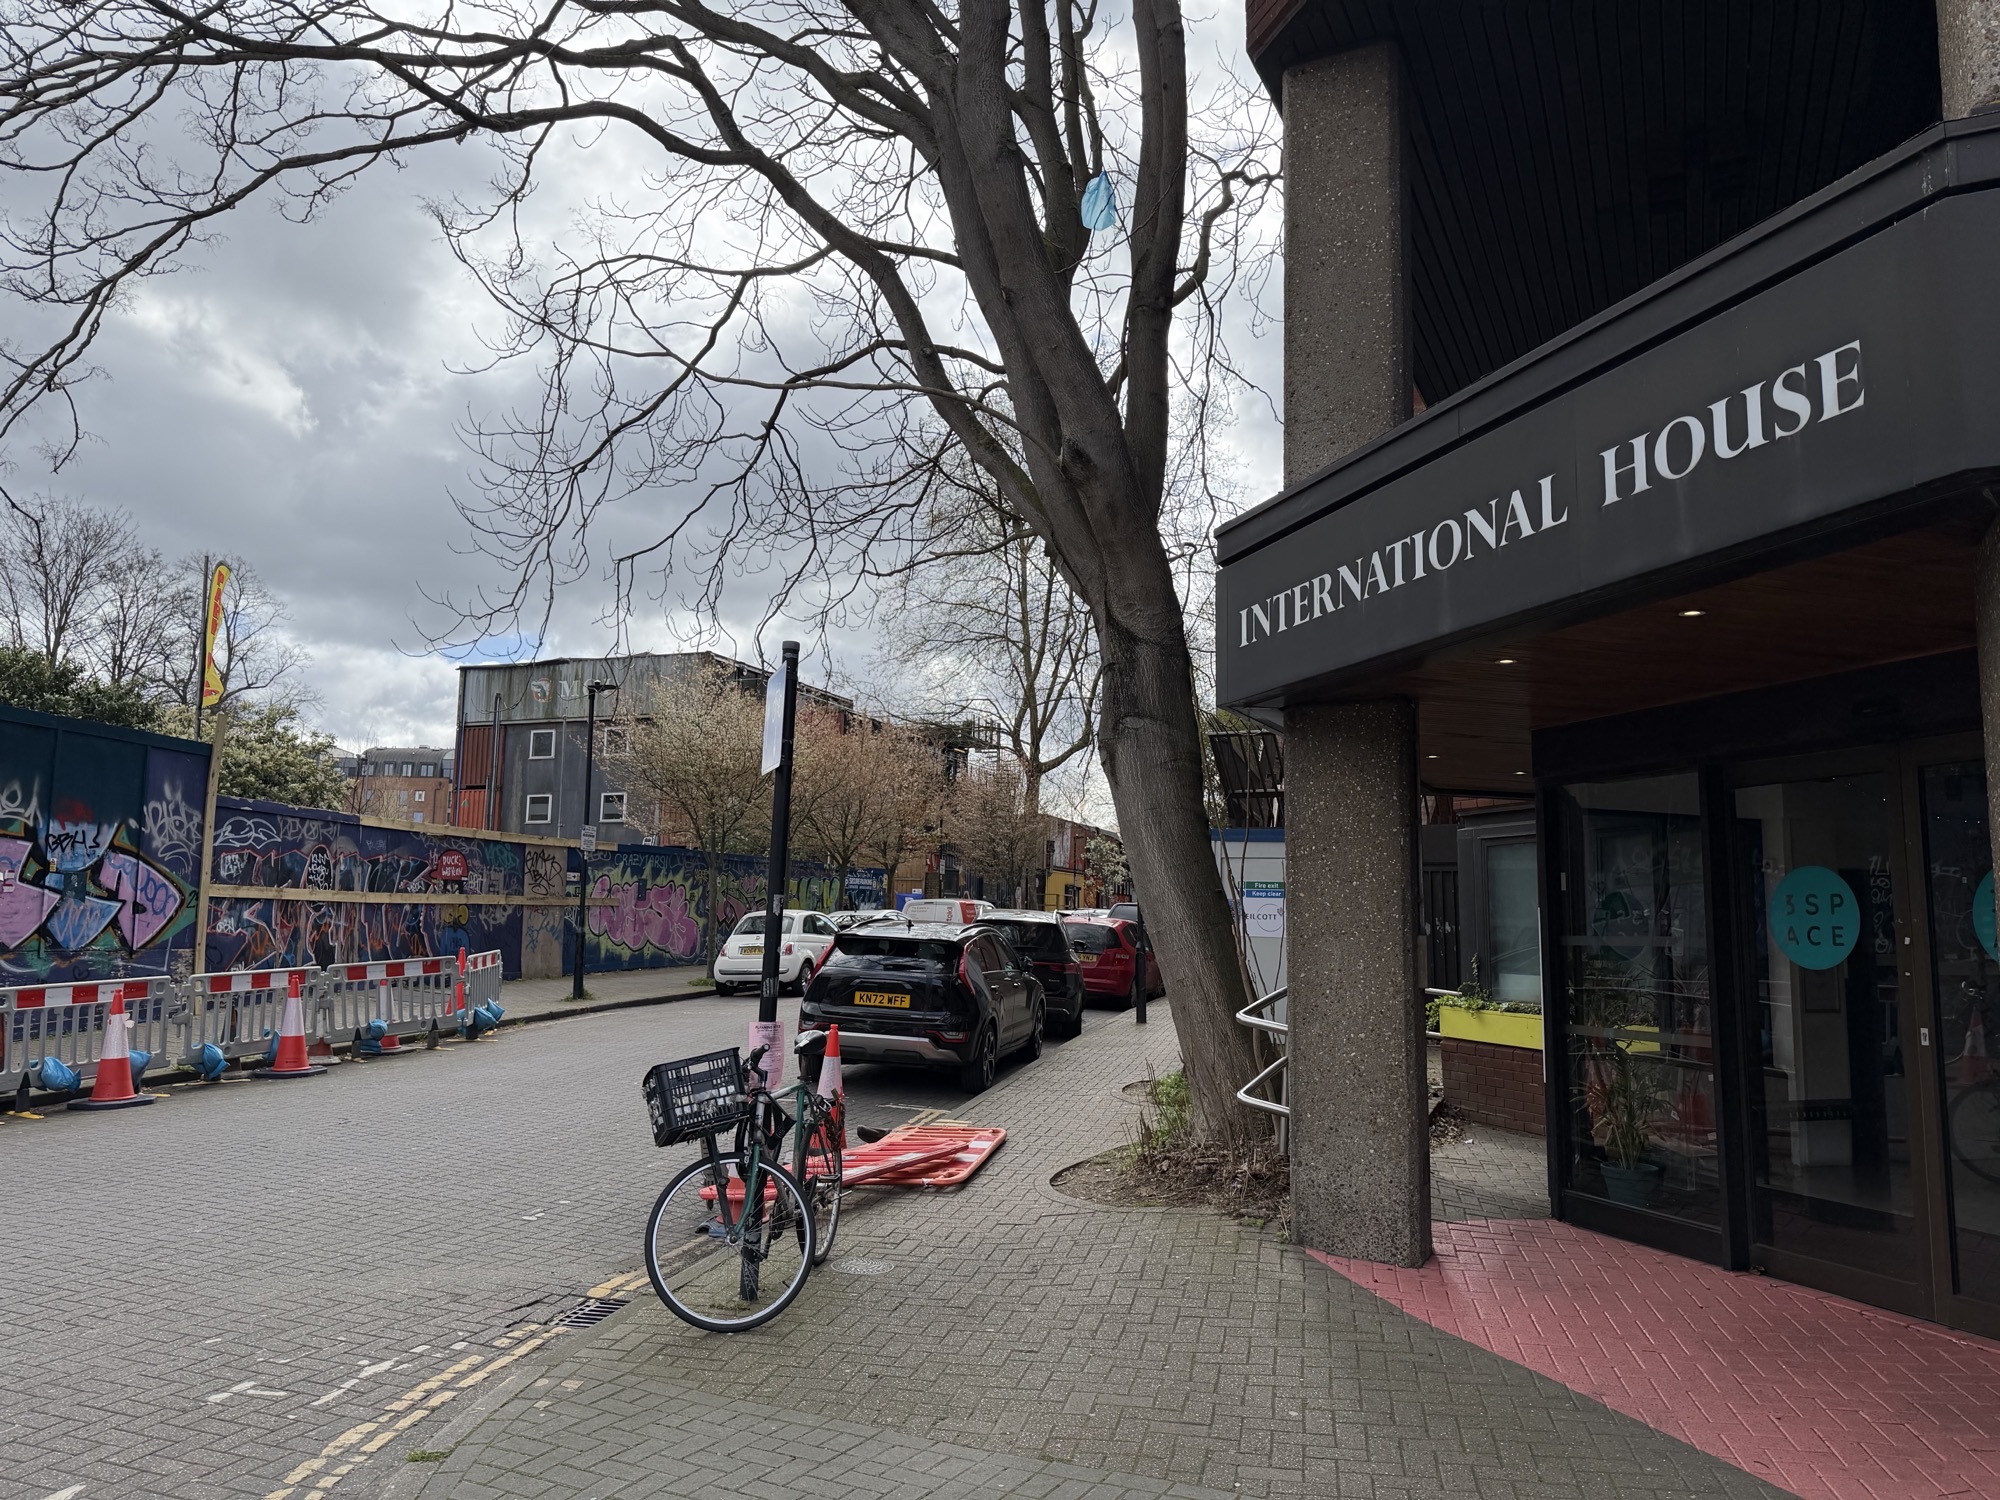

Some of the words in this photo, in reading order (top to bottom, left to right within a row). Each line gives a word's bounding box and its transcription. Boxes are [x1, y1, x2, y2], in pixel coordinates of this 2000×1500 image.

[1239, 473, 1568, 648] INTERNATIONAL
[1600, 339, 1866, 507] HOUSE
[1244, 913, 1278, 921] EILCOTT
[1786, 926, 1845, 947] ACE
[858, 993, 885, 1005] KN72
[887, 995, 907, 1006] WFF
